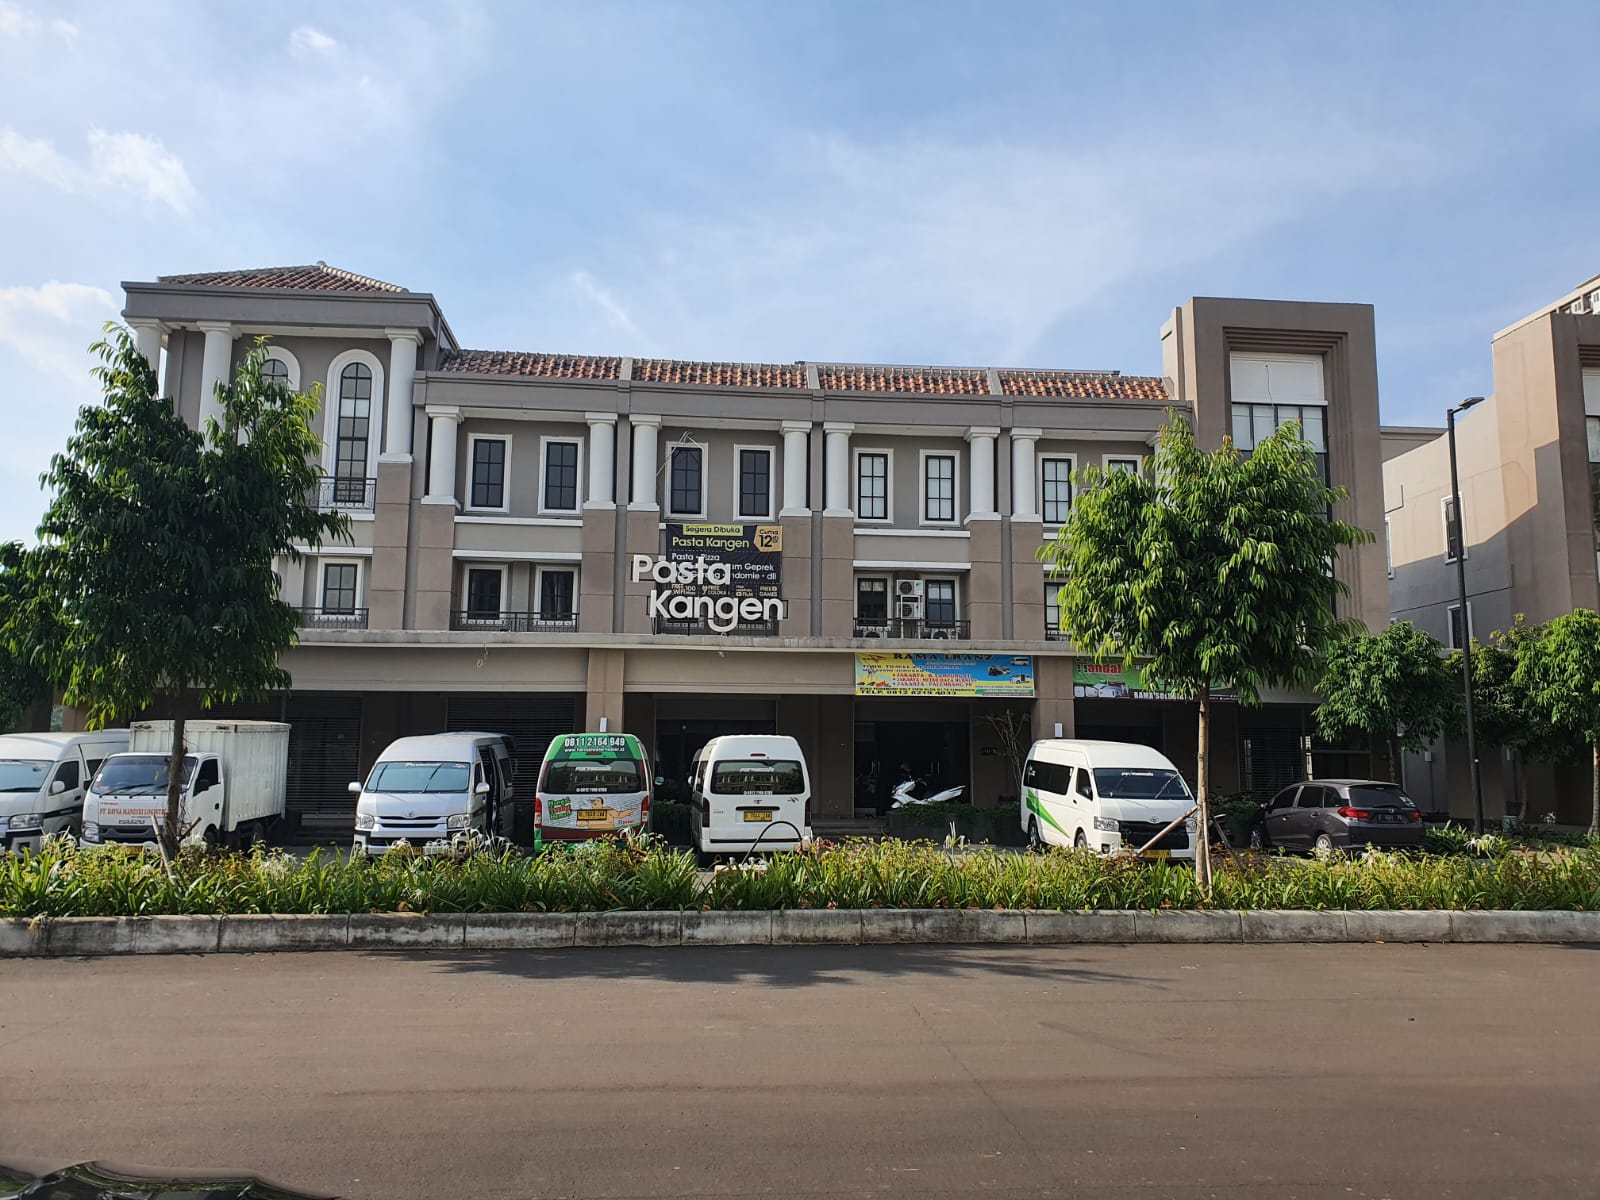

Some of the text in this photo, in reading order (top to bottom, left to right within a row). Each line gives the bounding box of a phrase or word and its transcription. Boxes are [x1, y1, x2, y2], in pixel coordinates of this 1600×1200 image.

[685, 526, 712, 534] Segera
[672, 537, 749, 551] Pasta Kangen
[759, 535, 772, 548] 12
[671, 552, 720, 561] Pasta Pizza
[632, 554, 731, 585] Pasta
[744, 563, 774, 572] Geprek
[650, 590, 784, 633] Kangen
[893, 652, 938, 660] RAMA
[944, 653, 993, 661] TRANZ
[564, 738, 585, 747] 0811
[610, 737, 625, 746] 949
